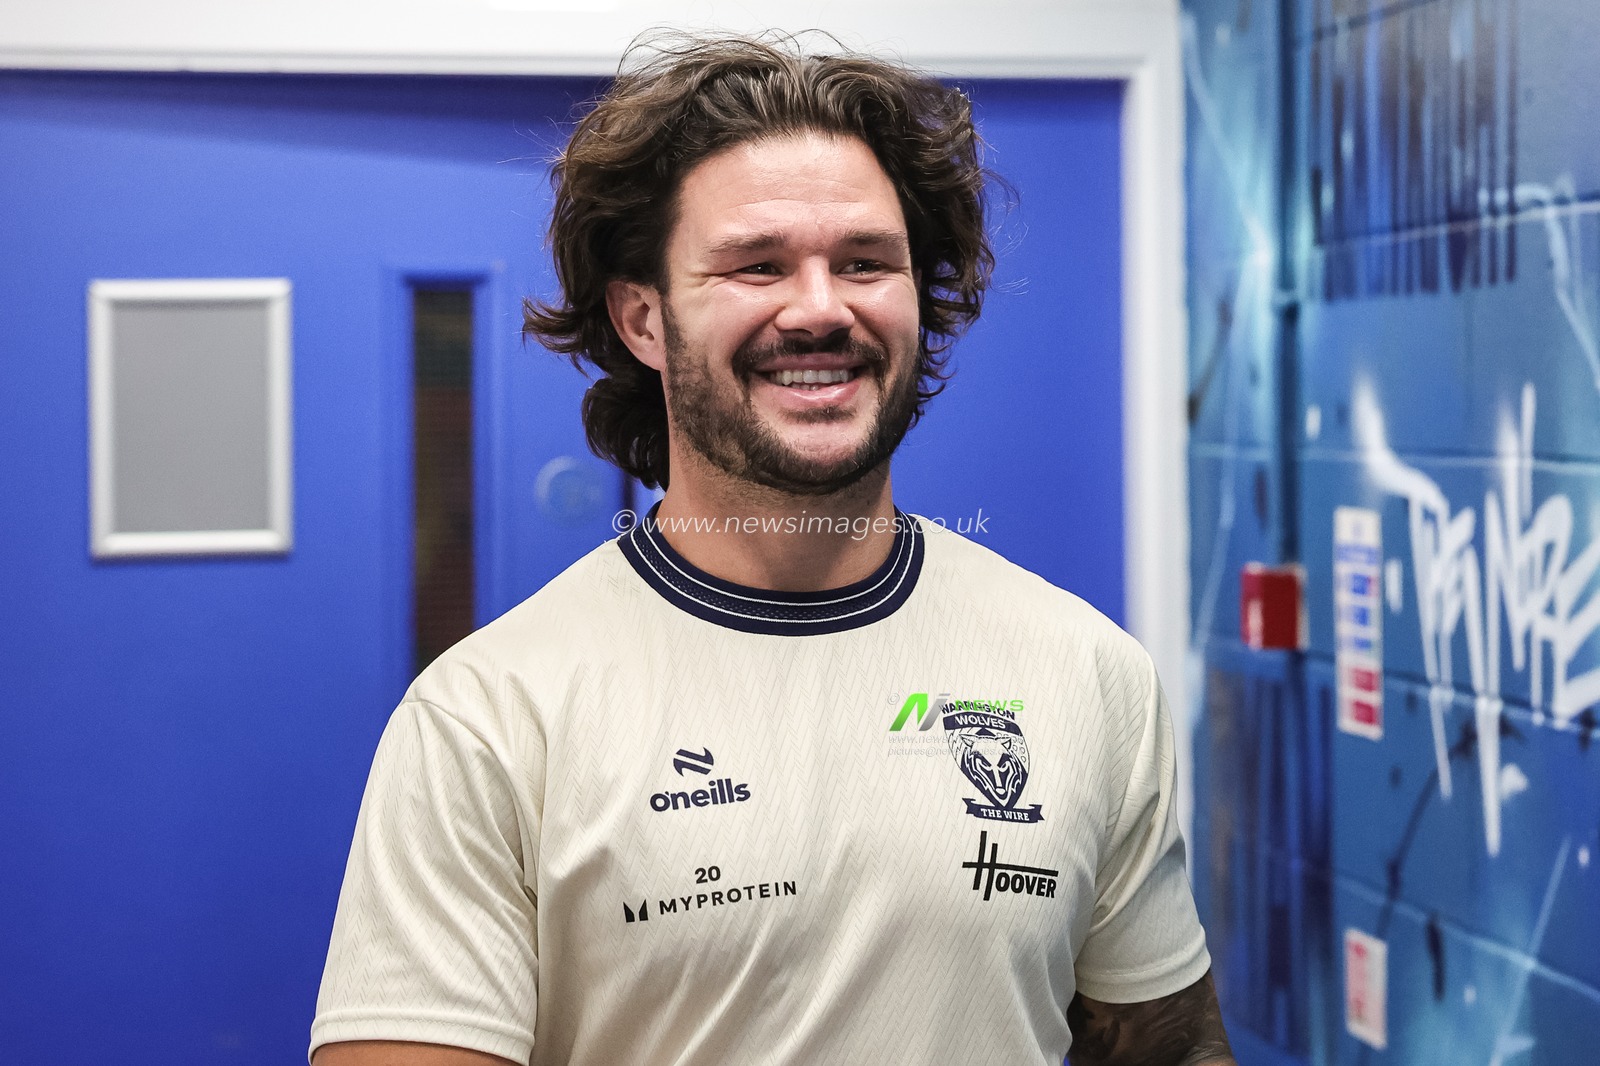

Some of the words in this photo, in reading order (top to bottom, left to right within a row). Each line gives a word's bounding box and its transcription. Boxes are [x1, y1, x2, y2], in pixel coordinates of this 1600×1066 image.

[955, 715, 1006, 730] WOLVES
[649, 778, 751, 812] o'neills
[980, 807, 1003, 819] THE
[1002, 809, 1030, 821] WIRE
[694, 865, 721, 884] 20
[962, 830, 1059, 901] HOOVER
[659, 881, 797, 915] MYPROTEIN
